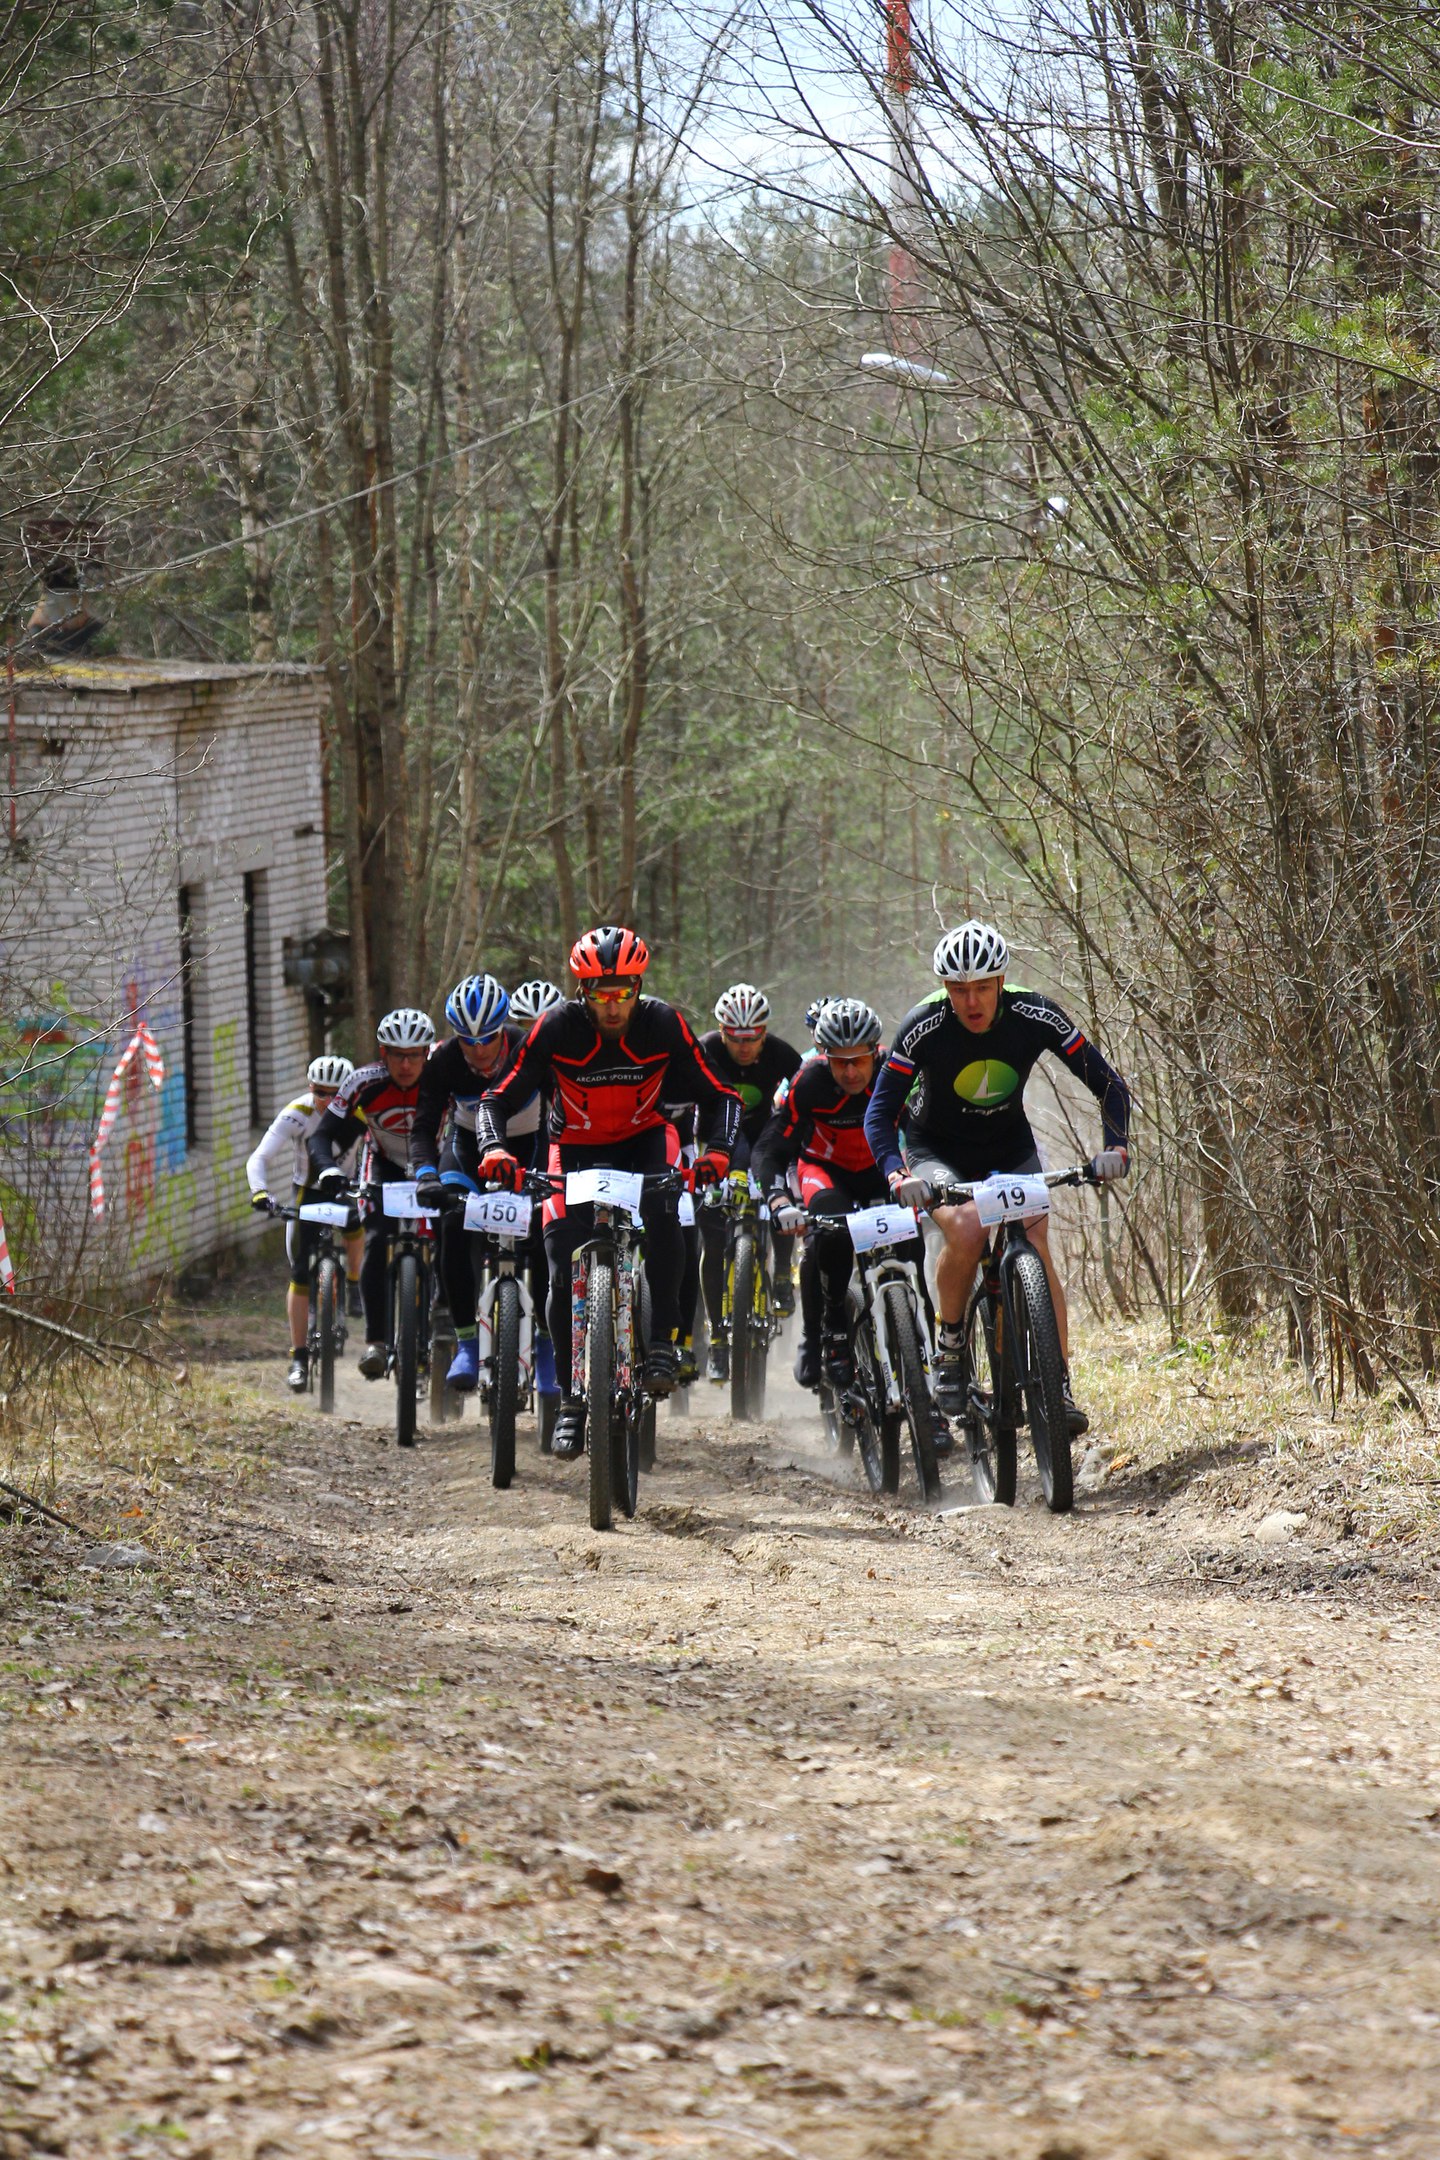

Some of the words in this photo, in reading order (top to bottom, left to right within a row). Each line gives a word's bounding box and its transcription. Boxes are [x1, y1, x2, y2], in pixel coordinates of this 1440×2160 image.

[576, 1075, 607, 1083] ARCADA
[597, 1180, 611, 1193] 2
[997, 1186, 1026, 1209] 19
[480, 1202, 518, 1223] 150
[876, 1217, 889, 1234] 5
